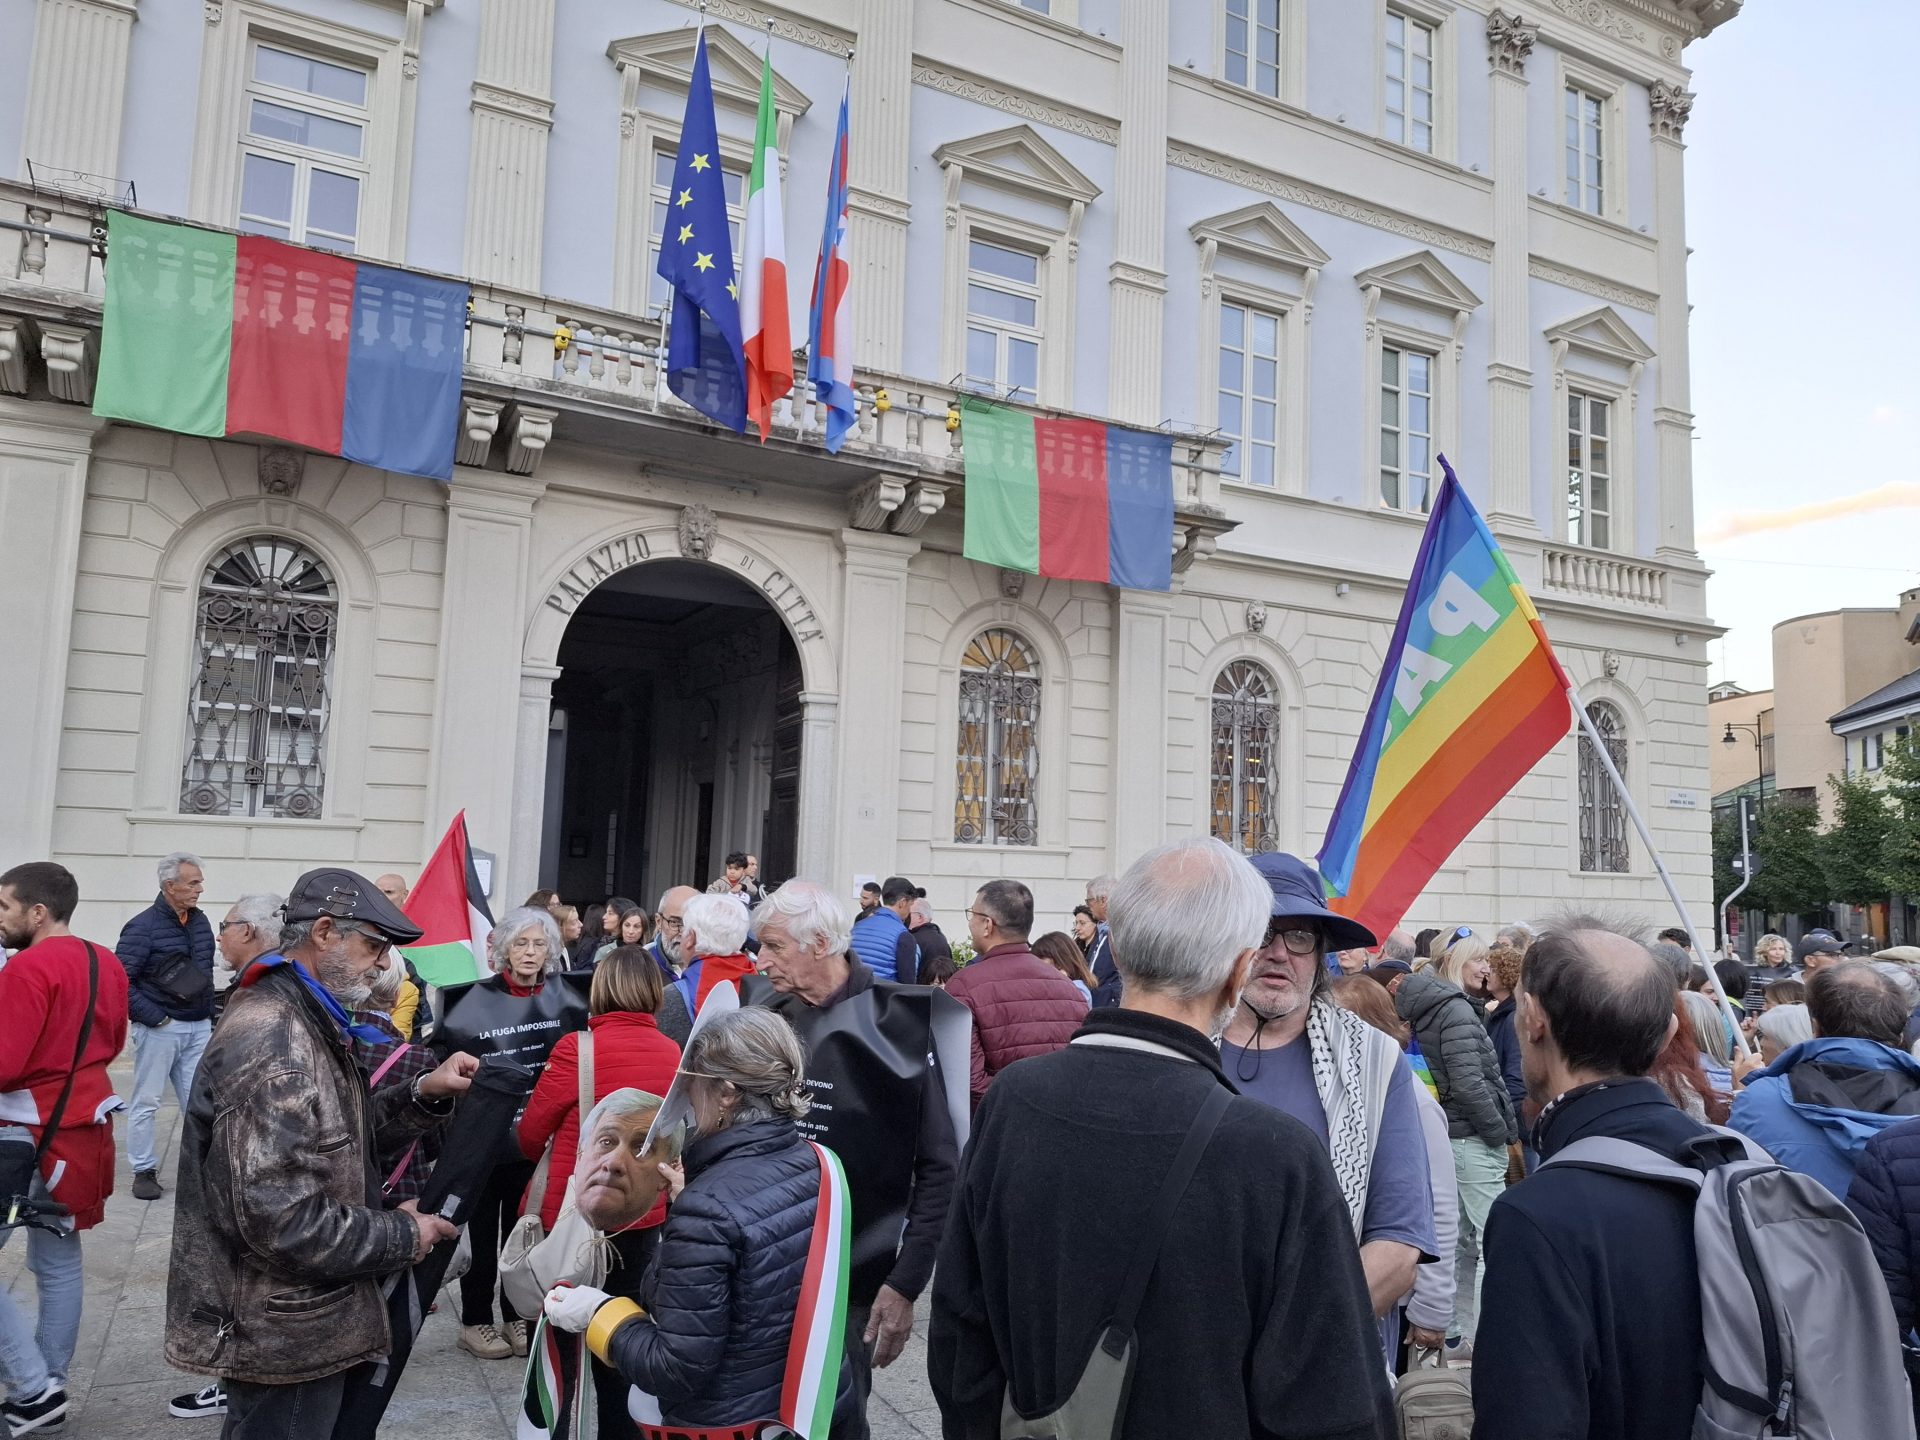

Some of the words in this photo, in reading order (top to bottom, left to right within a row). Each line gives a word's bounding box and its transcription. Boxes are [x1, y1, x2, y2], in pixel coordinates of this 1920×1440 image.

[545, 533, 652, 617] PALAZZO
[740, 555, 755, 570] DI
[479, 1031, 491, 1040] LA
[492, 1026, 517, 1037] FUGA
[517, 1019, 561, 1033] IMPOSSIBILE
[806, 1079, 834, 1090] DEVONO
[811, 1101, 833, 1111] Israele
[807, 1121, 814, 1129] in
[814, 1123, 829, 1132] atto
